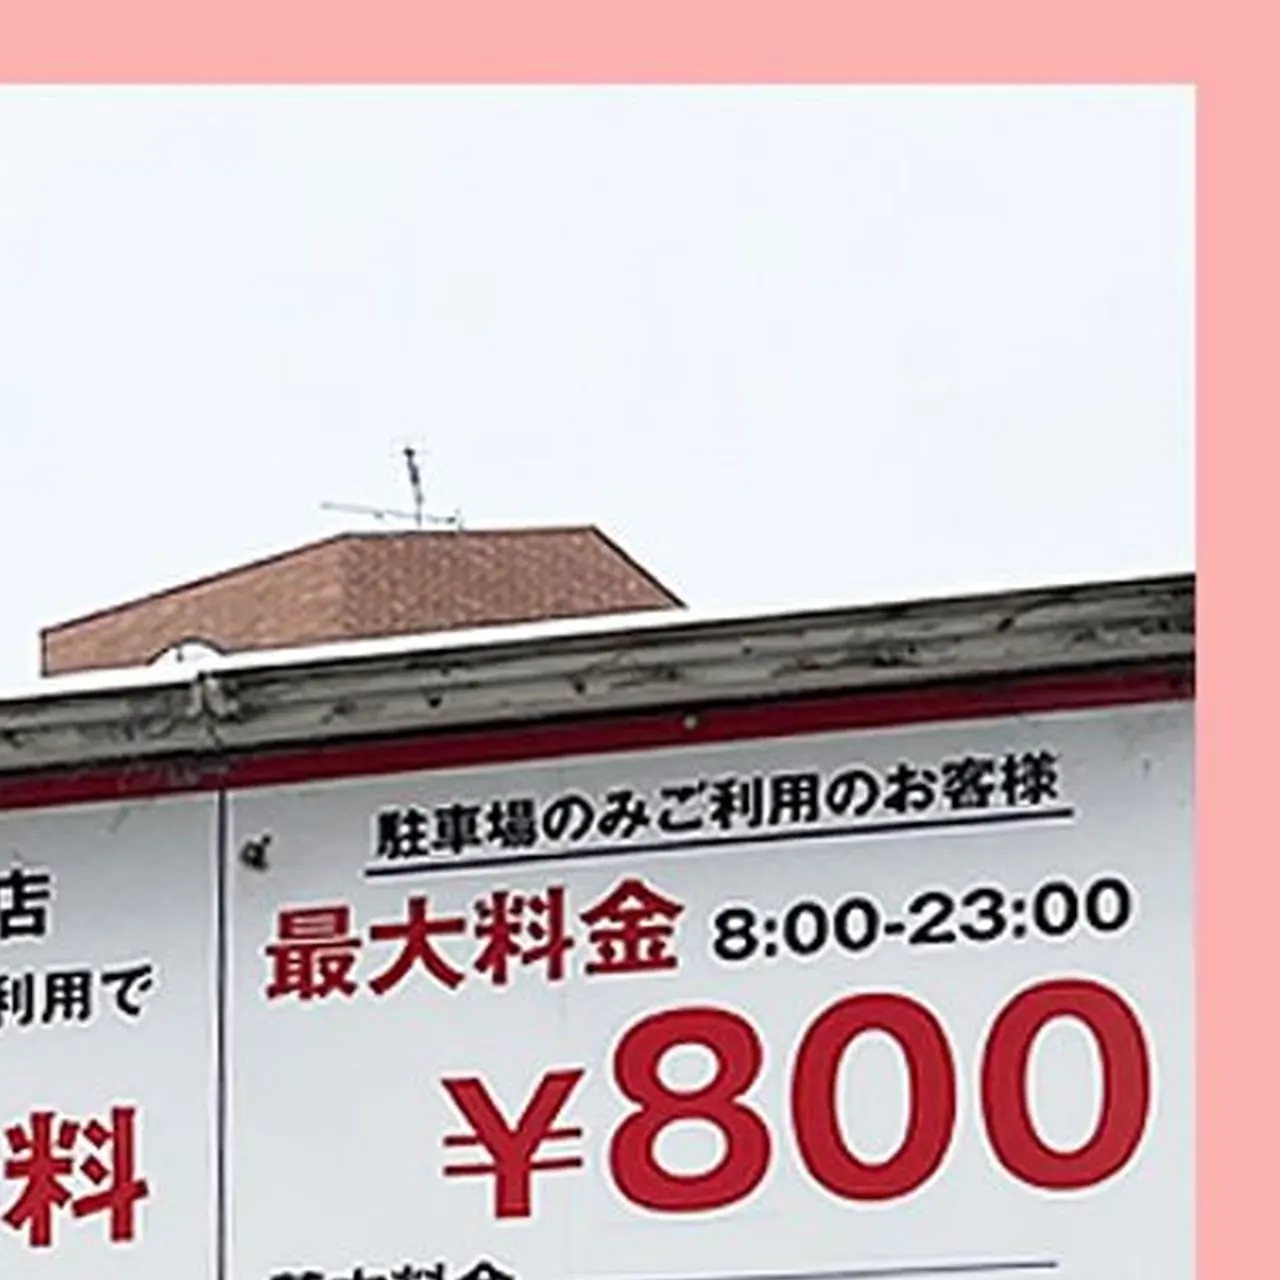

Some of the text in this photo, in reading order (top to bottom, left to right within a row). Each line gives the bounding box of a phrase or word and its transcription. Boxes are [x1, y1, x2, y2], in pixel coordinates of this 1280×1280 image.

[376, 751, 1062, 859] 駐車場のみご利用のお客様
[266, 877, 1132, 1002] 最大料金 8:00-23:00
[440, 977, 1153, 1219] ¥800
